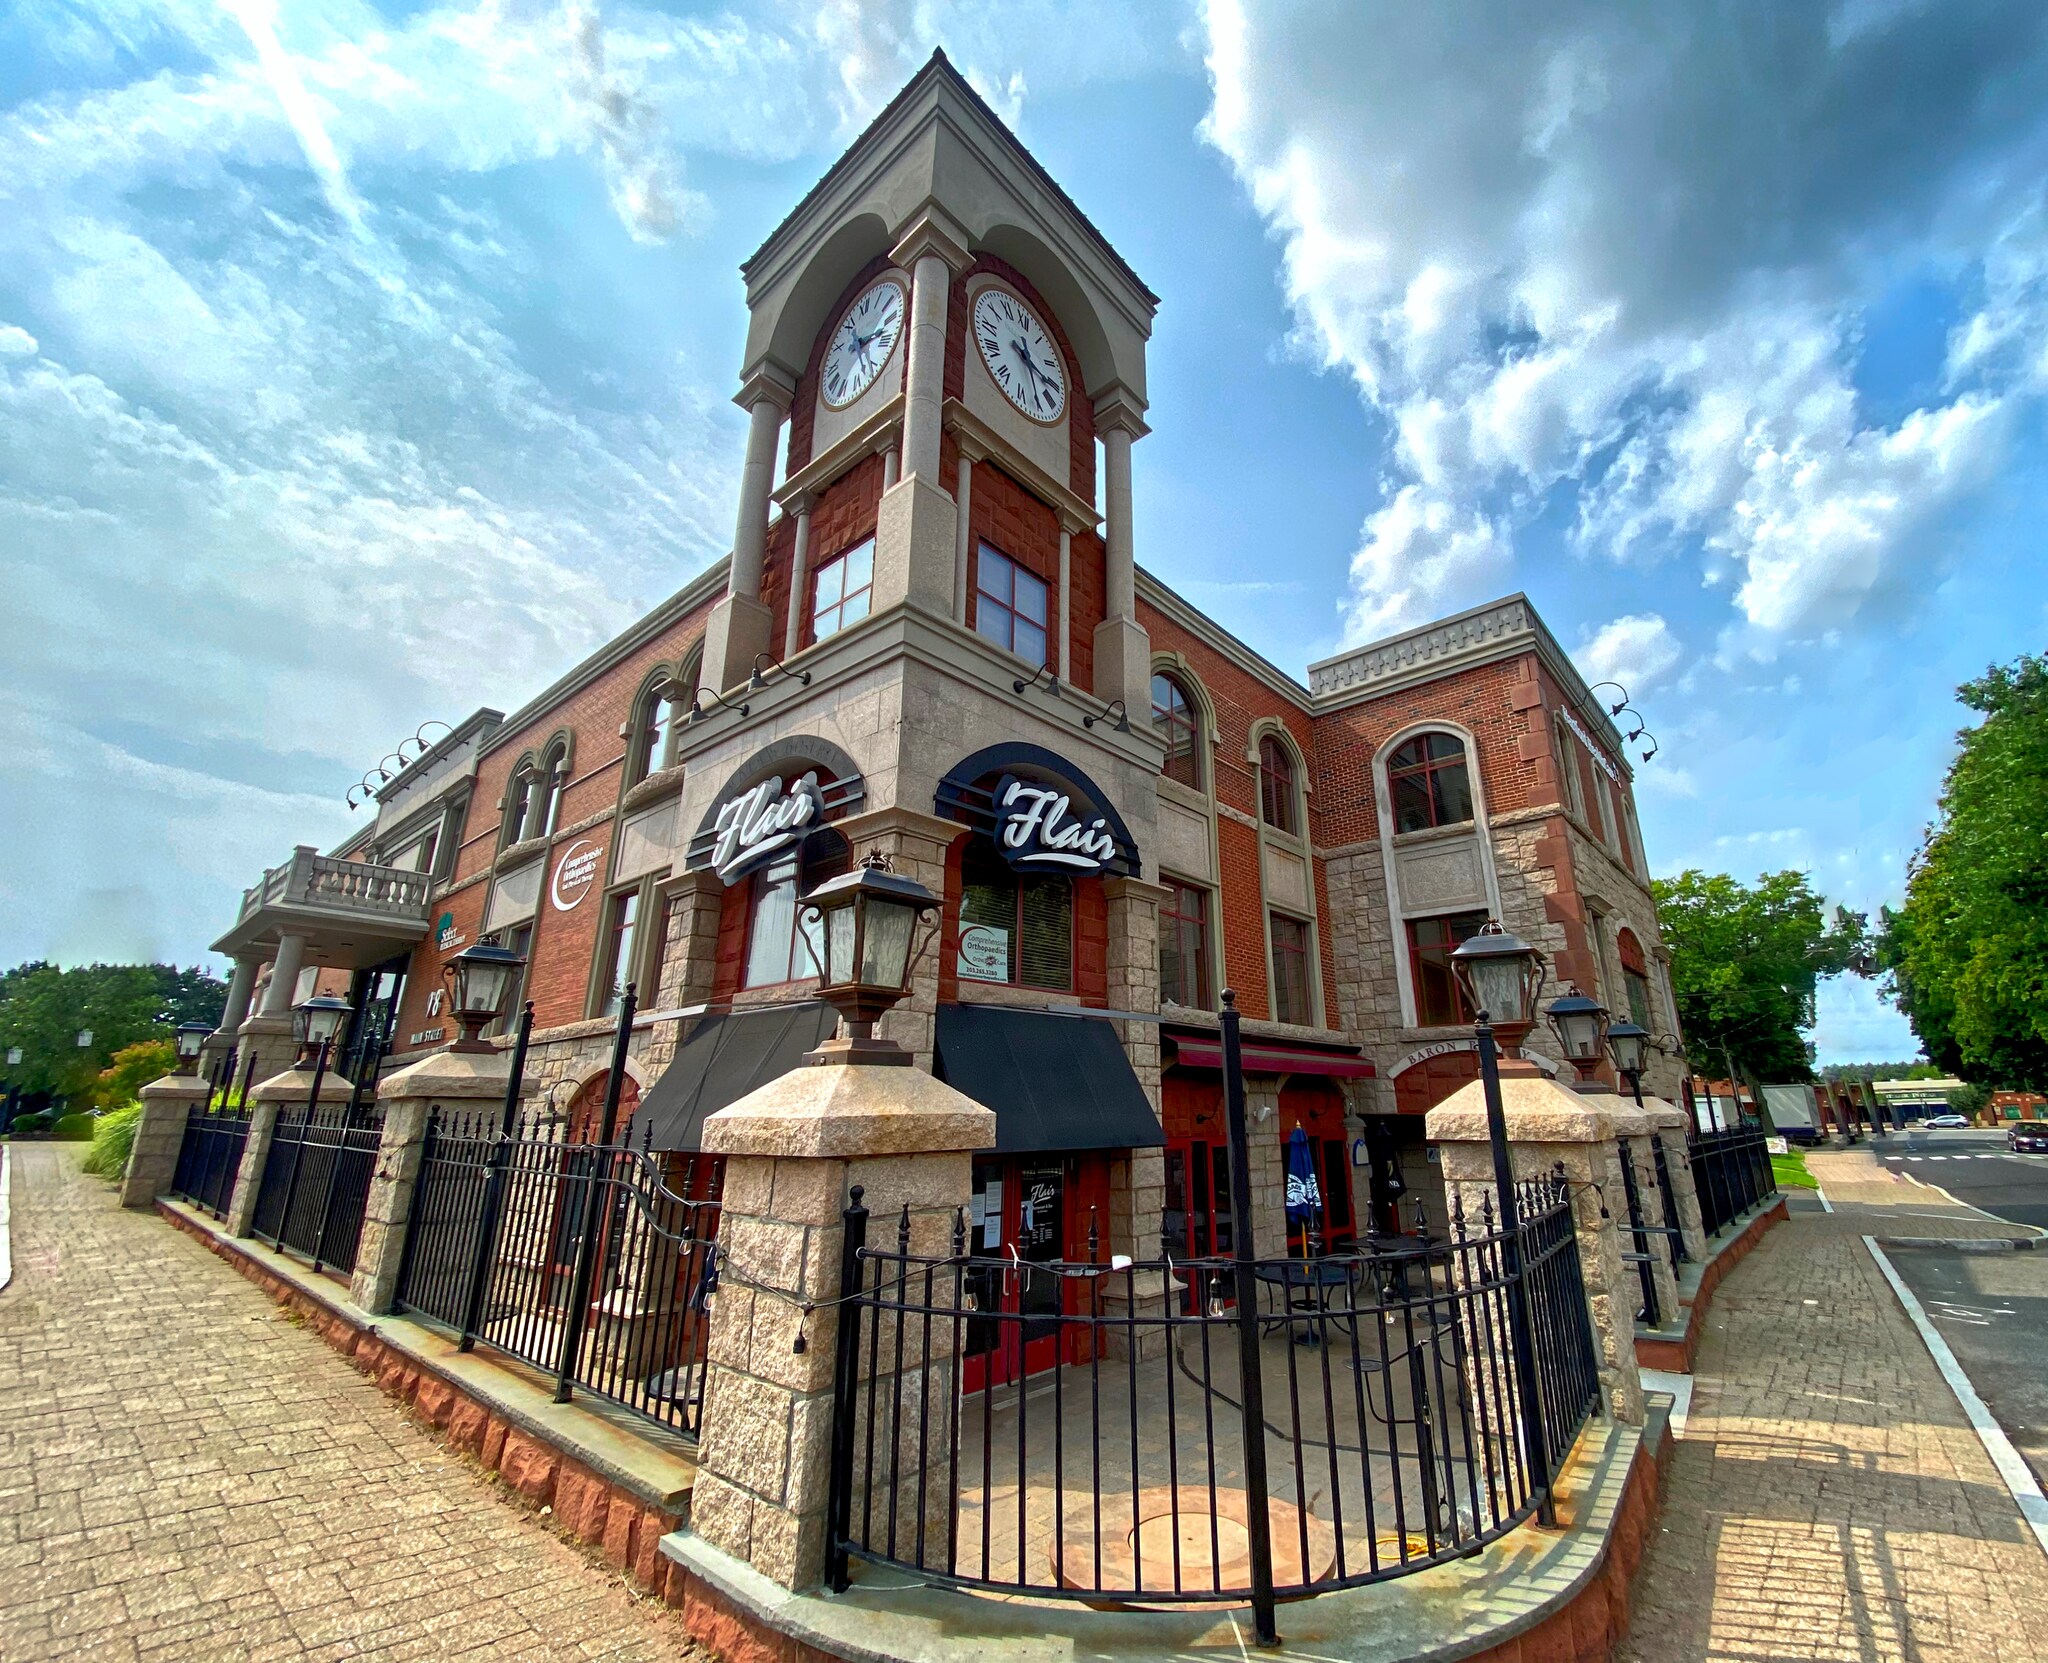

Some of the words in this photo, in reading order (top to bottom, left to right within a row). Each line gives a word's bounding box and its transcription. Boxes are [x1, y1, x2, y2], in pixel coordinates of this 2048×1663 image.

[712, 779, 814, 867] Flair
[1002, 781, 1116, 860] Flair
[967, 942, 1006, 954] Orthopaedics
[1408, 1042, 1457, 1065] BARON
[1031, 1183, 1055, 1203] Flair
